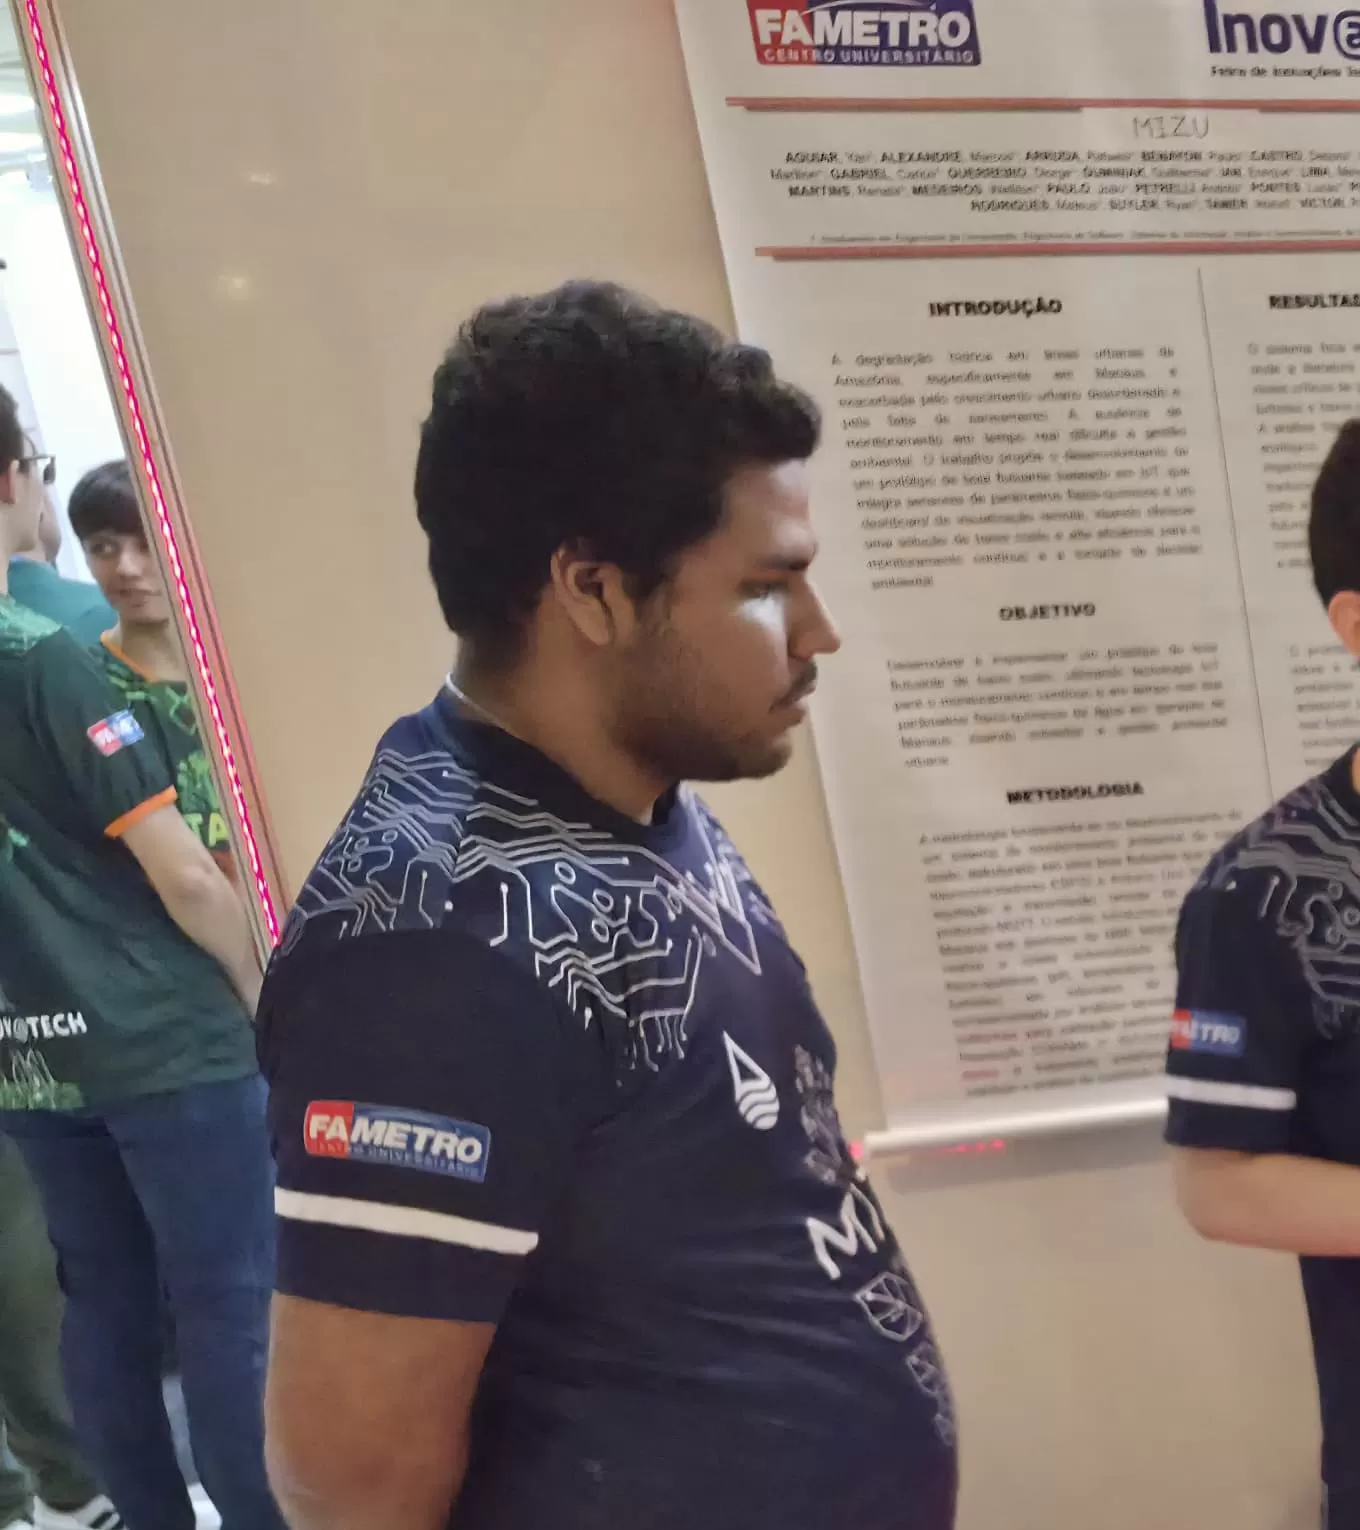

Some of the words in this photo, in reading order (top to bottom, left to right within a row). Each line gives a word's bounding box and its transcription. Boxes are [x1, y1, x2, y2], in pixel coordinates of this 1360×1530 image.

[754, 8, 971, 48] FAMETRO
[1131, 114, 1210, 140] MIZU
[928, 297, 1063, 318] INTRODUÇÃO
[999, 603, 1096, 622] OBJETIVO
[1006, 781, 1144, 805] METODOLOGIA
[309, 1113, 483, 1164] FAMETRO
